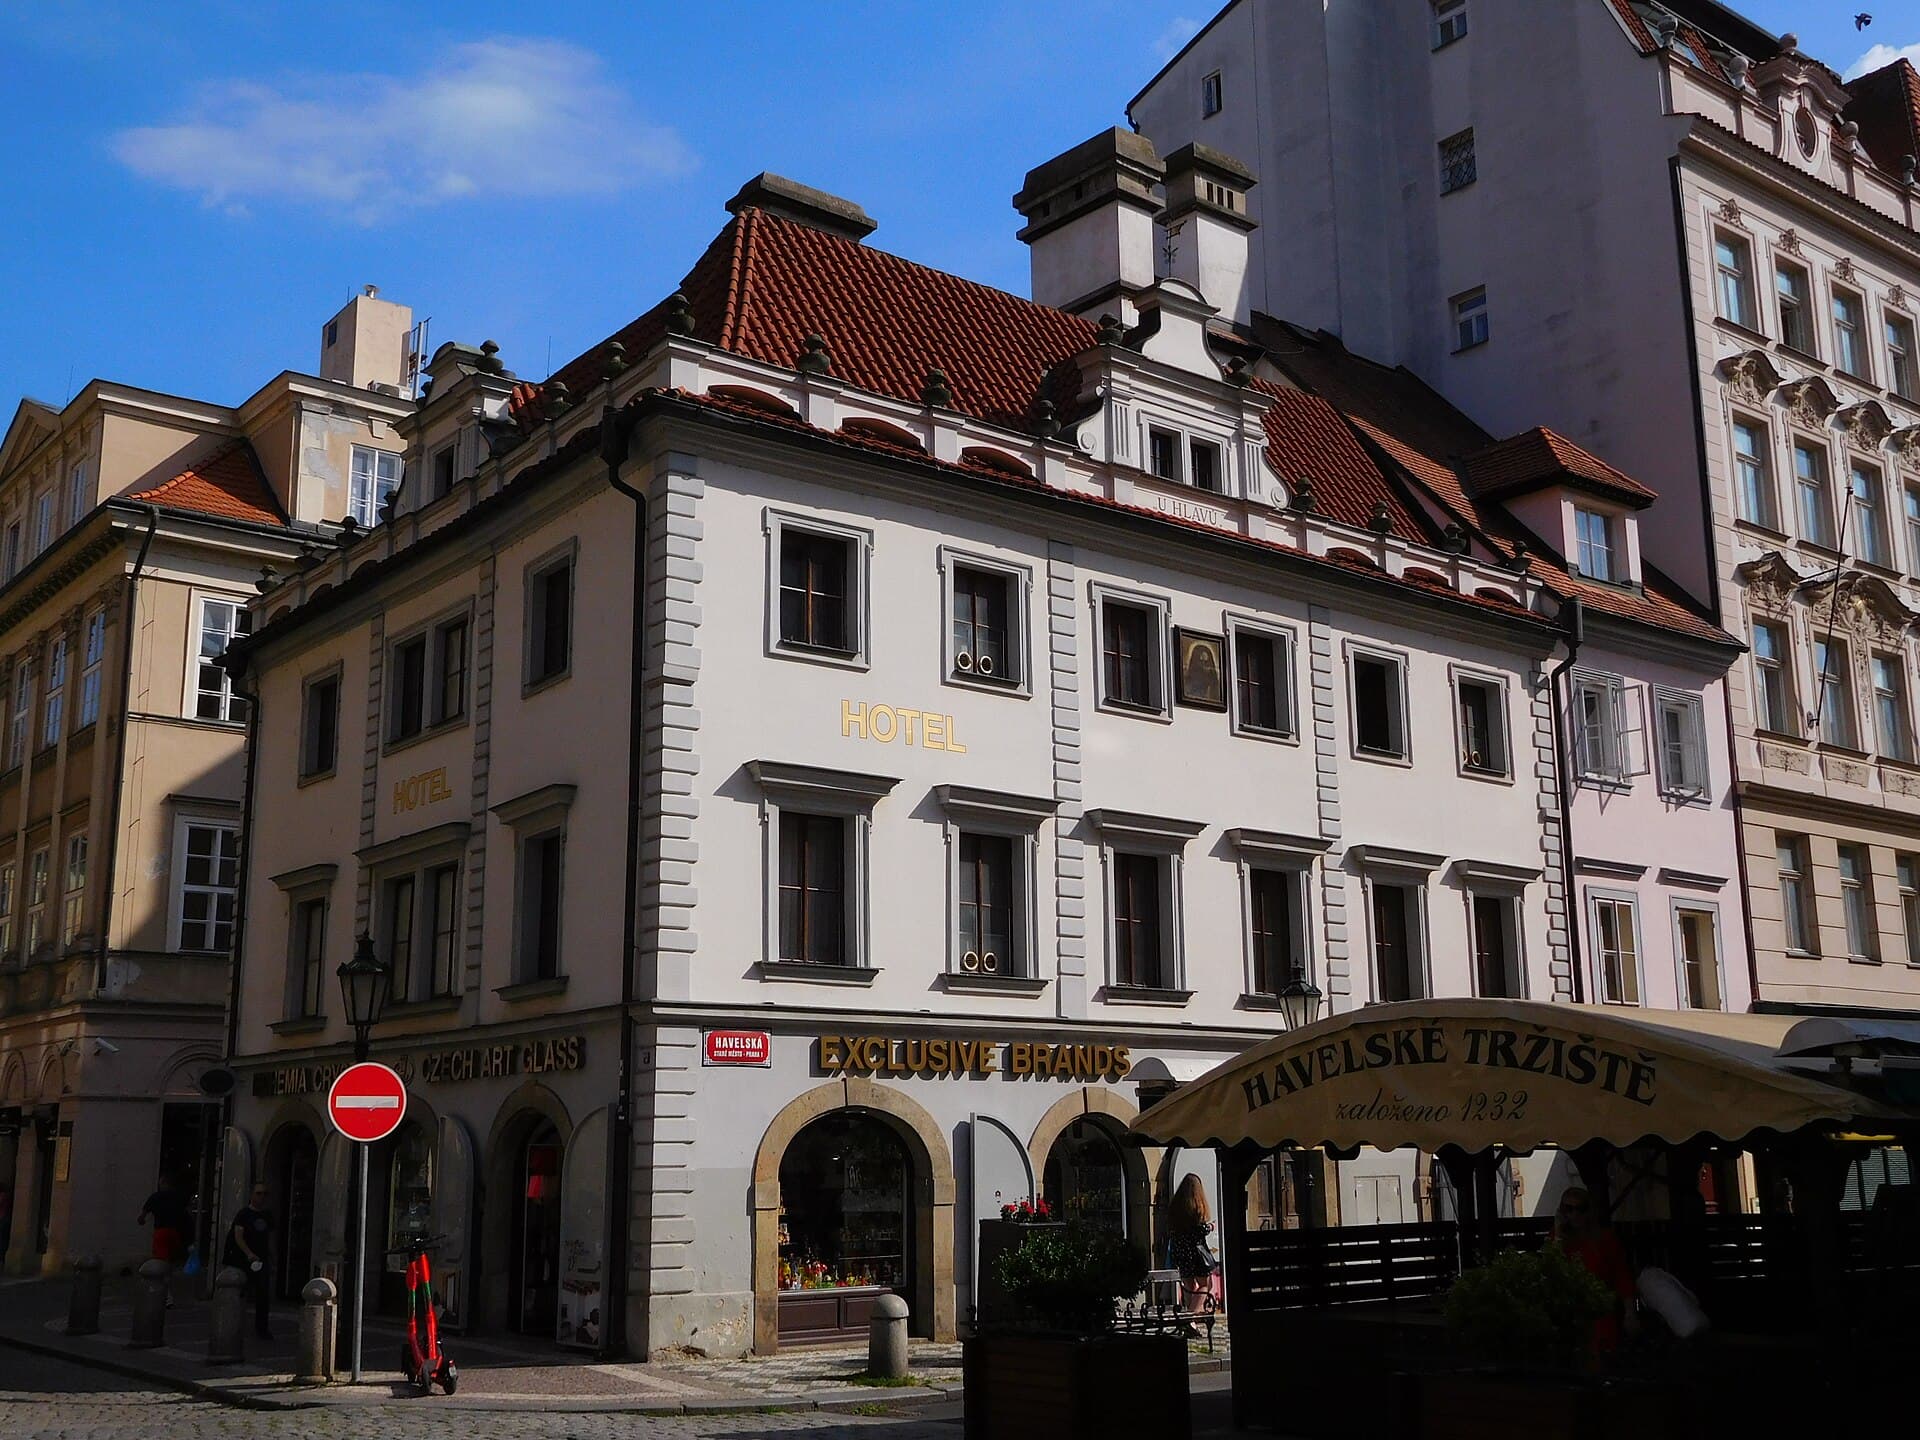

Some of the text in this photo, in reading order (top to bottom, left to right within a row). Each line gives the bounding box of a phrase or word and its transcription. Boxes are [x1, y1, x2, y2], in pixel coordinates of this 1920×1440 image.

[841, 699, 967, 753] HOTEL
[393, 766, 452, 815] HOTEL
[422, 1049, 475, 1083] CZECH
[480, 1045, 514, 1078] ART
[523, 1036, 580, 1073] GLASS
[715, 1036, 763, 1049] HAVELSKÁ
[820, 1036, 1132, 1077] EXCLUSIVE BRANDS
[1241, 1019, 1657, 1113] HAVELSKÉ TRŽIŠTĚ
[1335, 1088, 1529, 1122] založeno 1232
